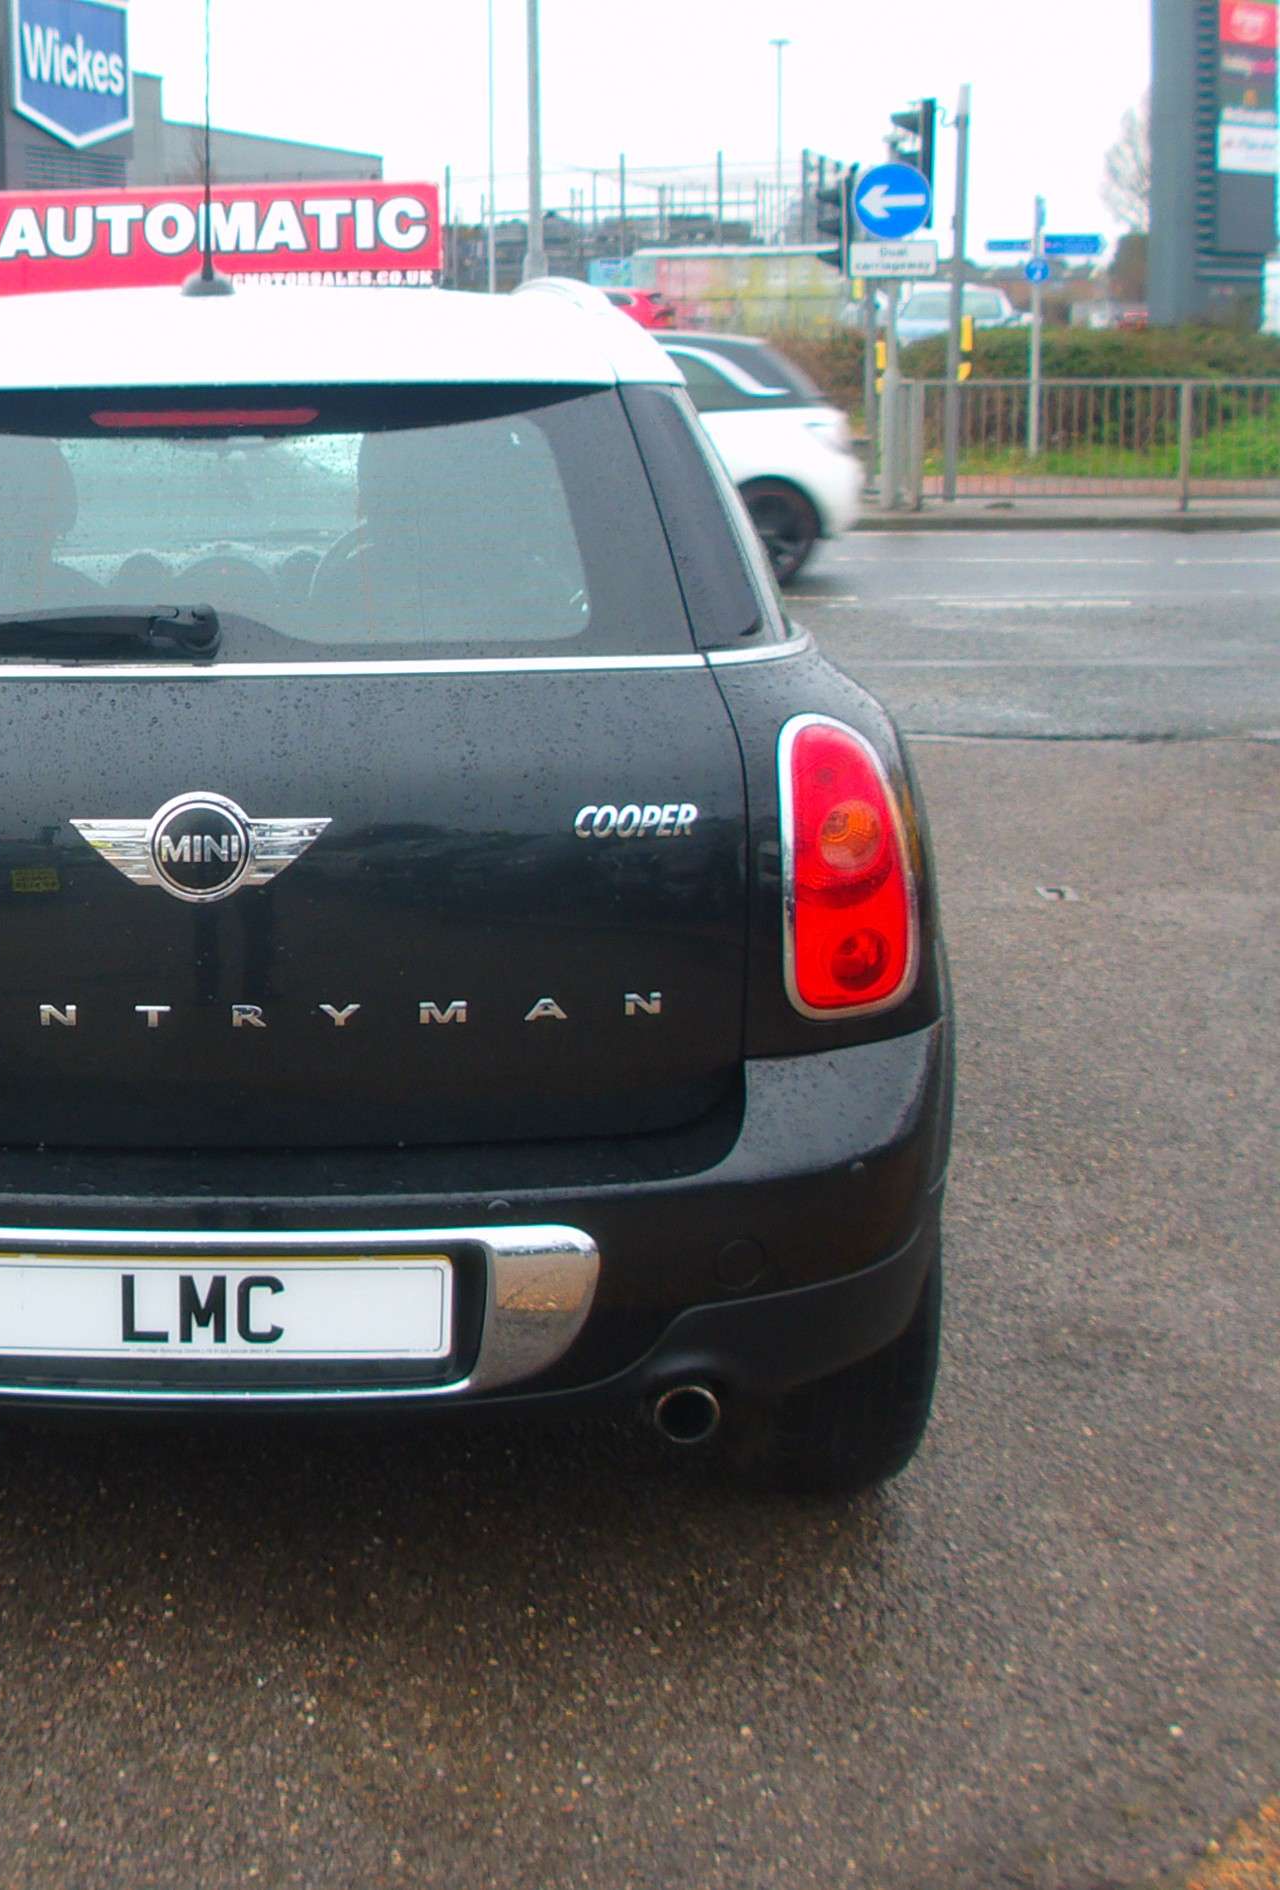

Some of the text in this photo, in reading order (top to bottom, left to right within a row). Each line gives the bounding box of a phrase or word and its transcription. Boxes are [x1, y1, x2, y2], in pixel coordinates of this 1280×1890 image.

[22, 21, 125, 96] Wickes
[575, 803, 698, 838] COOPER
[161, 834, 239, 863] MINI
[121, 1273, 285, 1345] LMC
